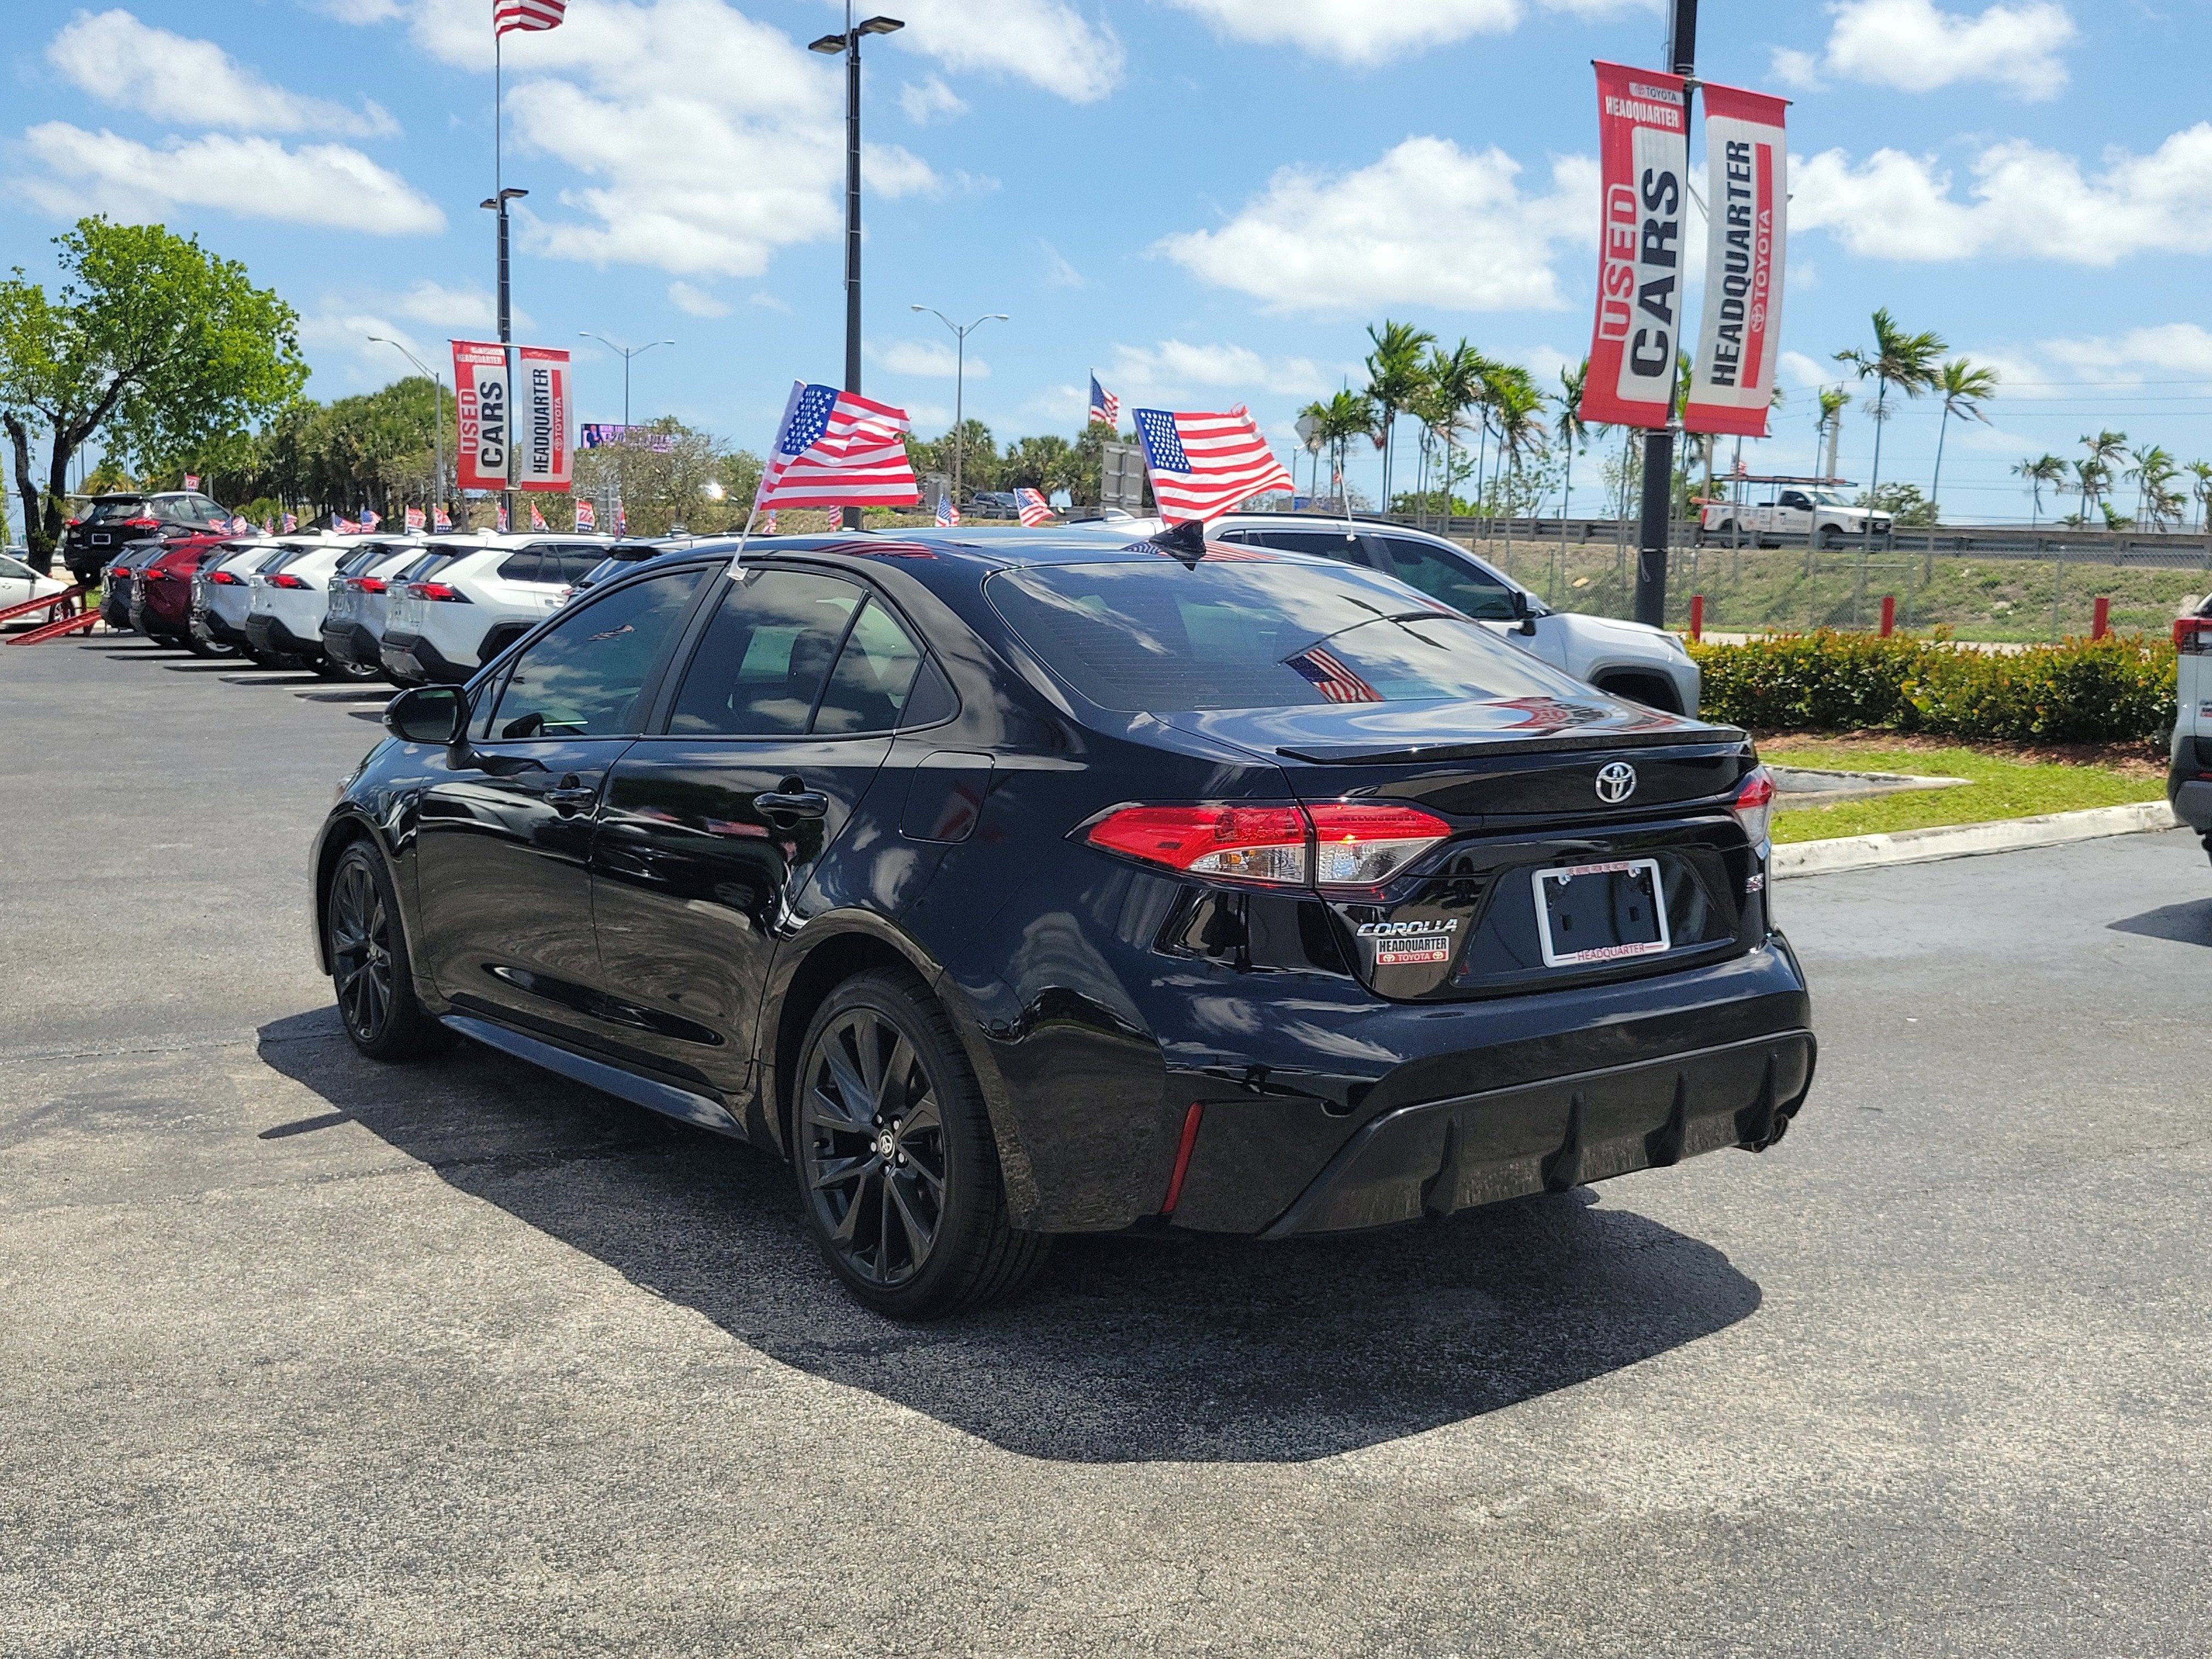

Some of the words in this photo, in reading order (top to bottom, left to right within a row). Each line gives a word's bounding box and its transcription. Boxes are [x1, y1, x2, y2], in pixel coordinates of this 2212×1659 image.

[1605, 95, 1679, 128] HEADQUARTER
[1646, 87, 1677, 102] TOYOTA
[1599, 185, 1636, 340] USED
[1630, 167, 1679, 377] CARS
[1710, 140, 1750, 387] HEADQUARTER
[1753, 208, 1771, 300] TOYOTA
[461, 391, 479, 452] USED
[480, 381, 504, 468] CARS
[533, 369, 551, 473] HEADQUARTER
[554, 397, 563, 437] TOYOTA
[1357, 918, 1458, 937] COROLLA
[1379, 938, 1447, 952] HEADQUARTER
[1577, 944, 1645, 961] HEADQUARTER
[1397, 952, 1431, 962] TOYOTA
